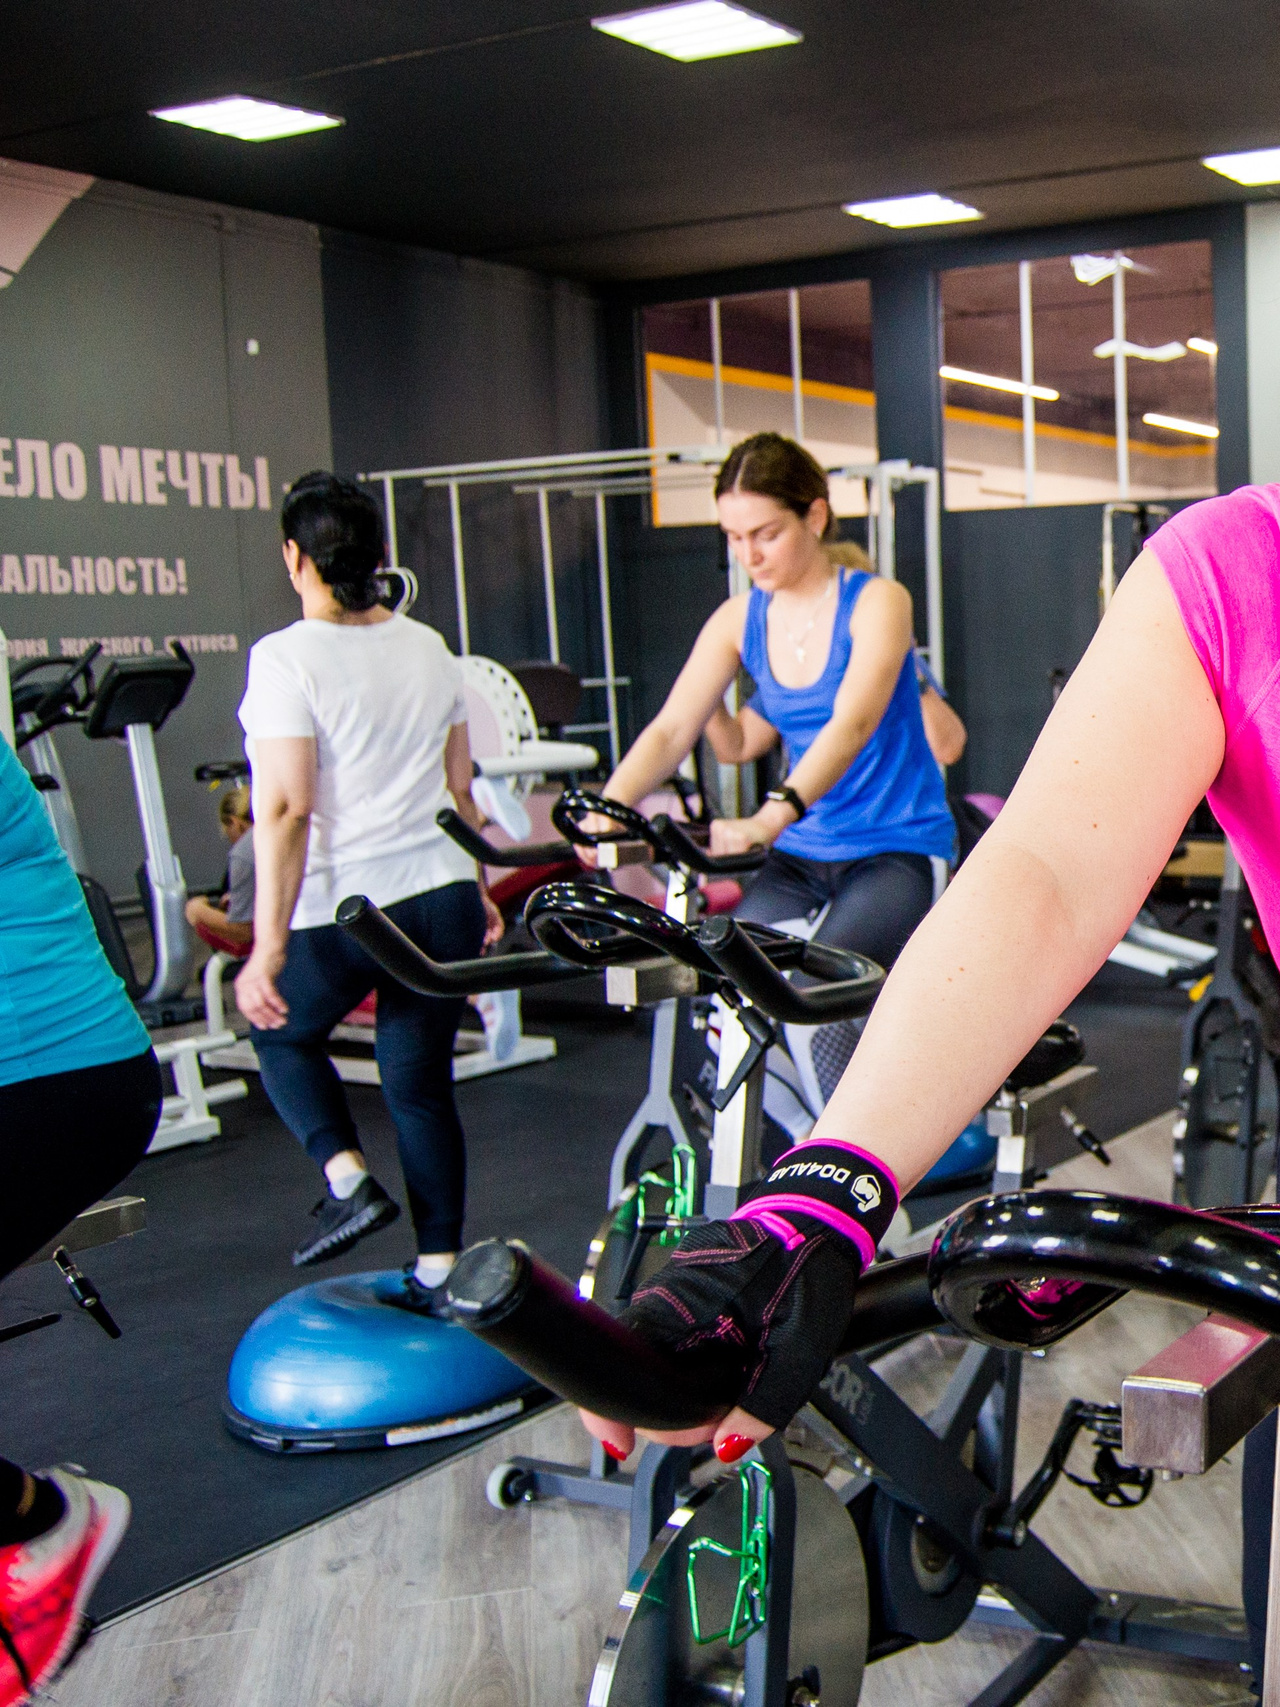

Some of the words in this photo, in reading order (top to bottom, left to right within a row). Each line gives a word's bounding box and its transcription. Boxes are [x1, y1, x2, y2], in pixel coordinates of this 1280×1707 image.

[99, 444, 271, 511] МЕЧТЫ
[0, 554, 189, 596] АЛЬНОСТЬ!
[768, 1162, 851, 1184] DO4ALAB
